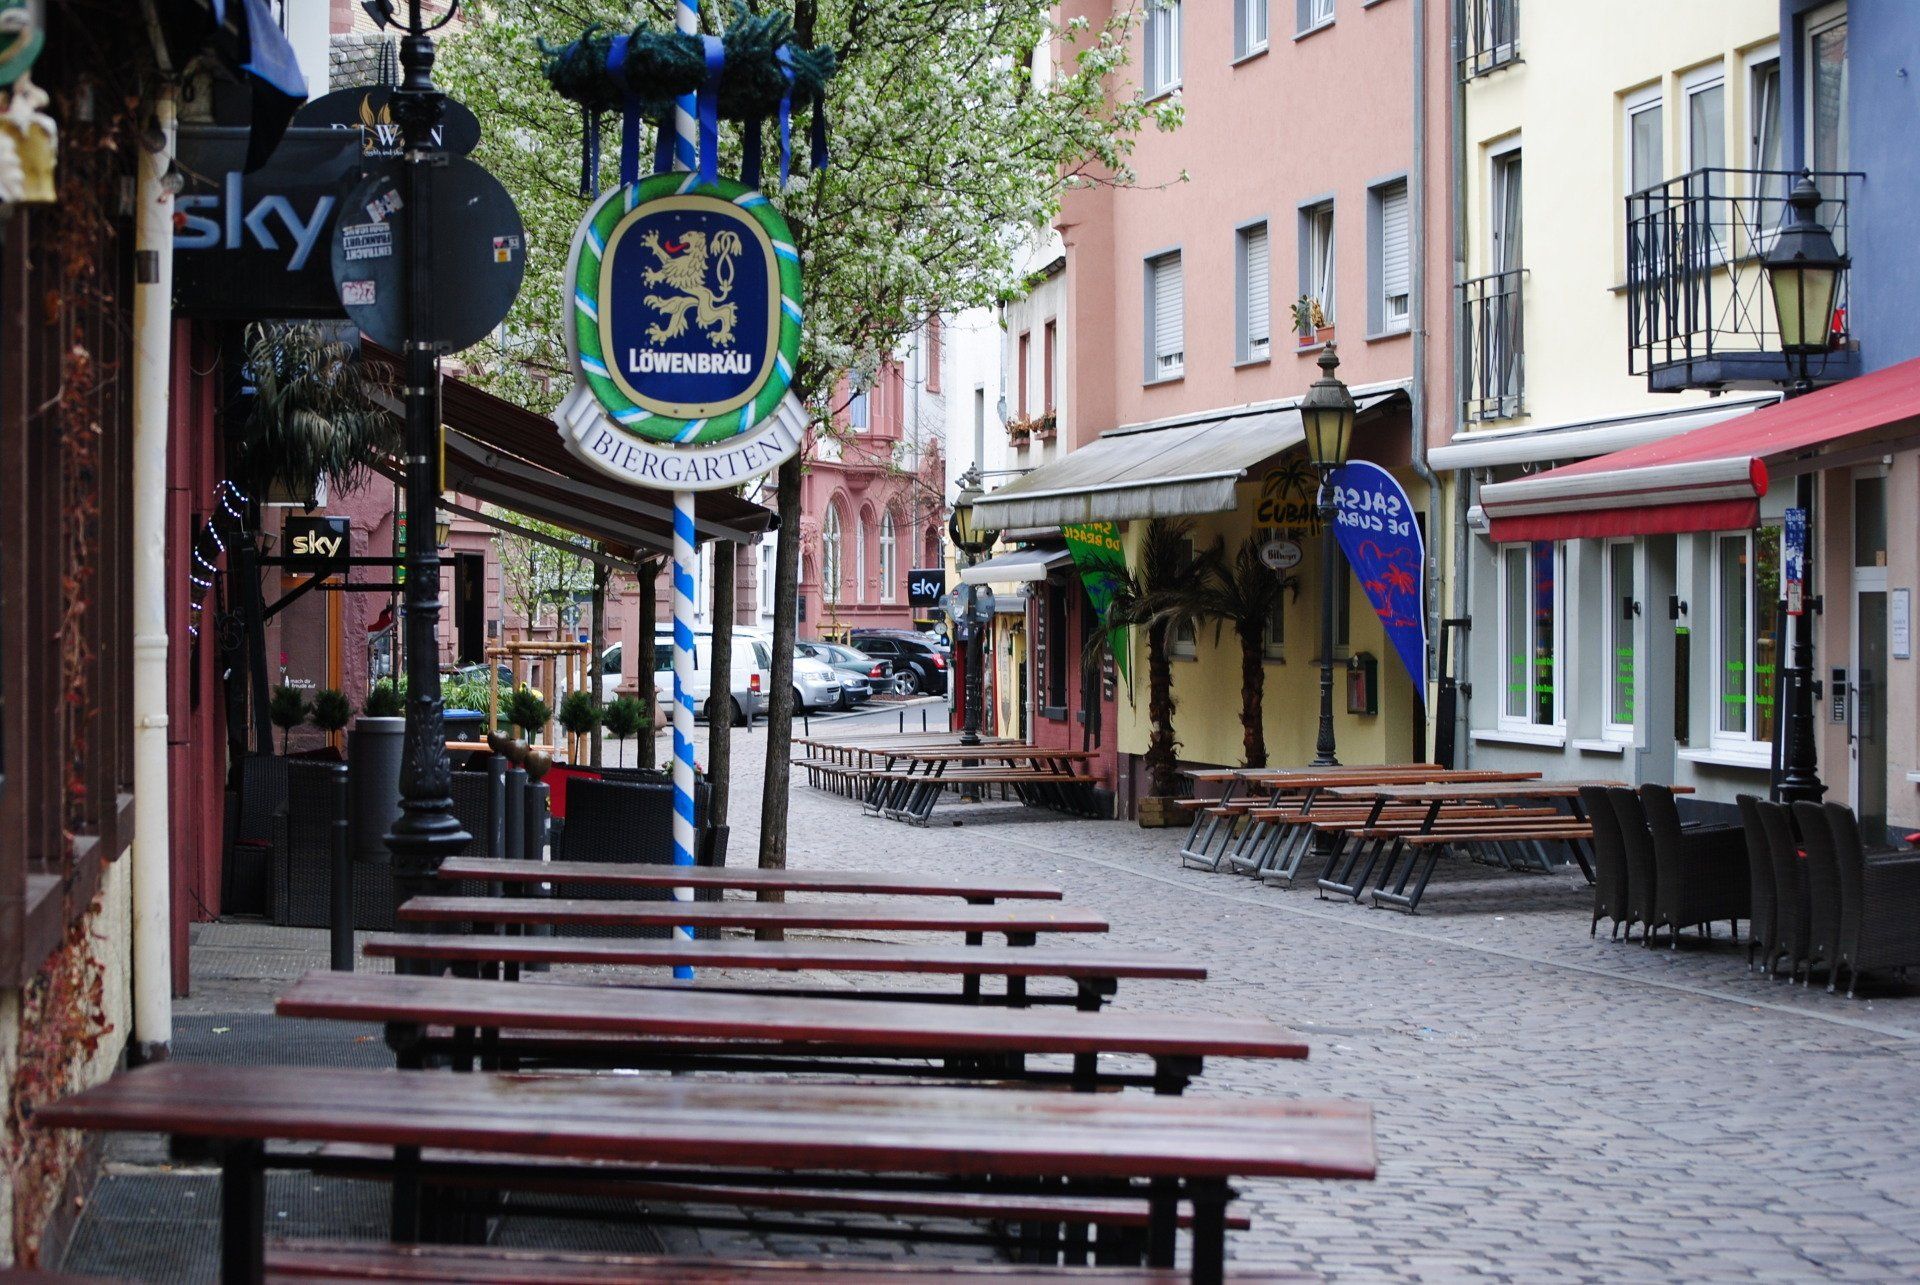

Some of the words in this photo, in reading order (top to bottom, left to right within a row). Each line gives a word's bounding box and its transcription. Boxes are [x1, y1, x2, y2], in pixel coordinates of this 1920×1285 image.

[173, 171, 336, 271] sky
[629, 348, 752, 375] LÖWENBRÄU
[592, 430, 785, 482] BIERGARTEN
[292, 529, 342, 558] sky
[911, 578, 941, 599] sky
